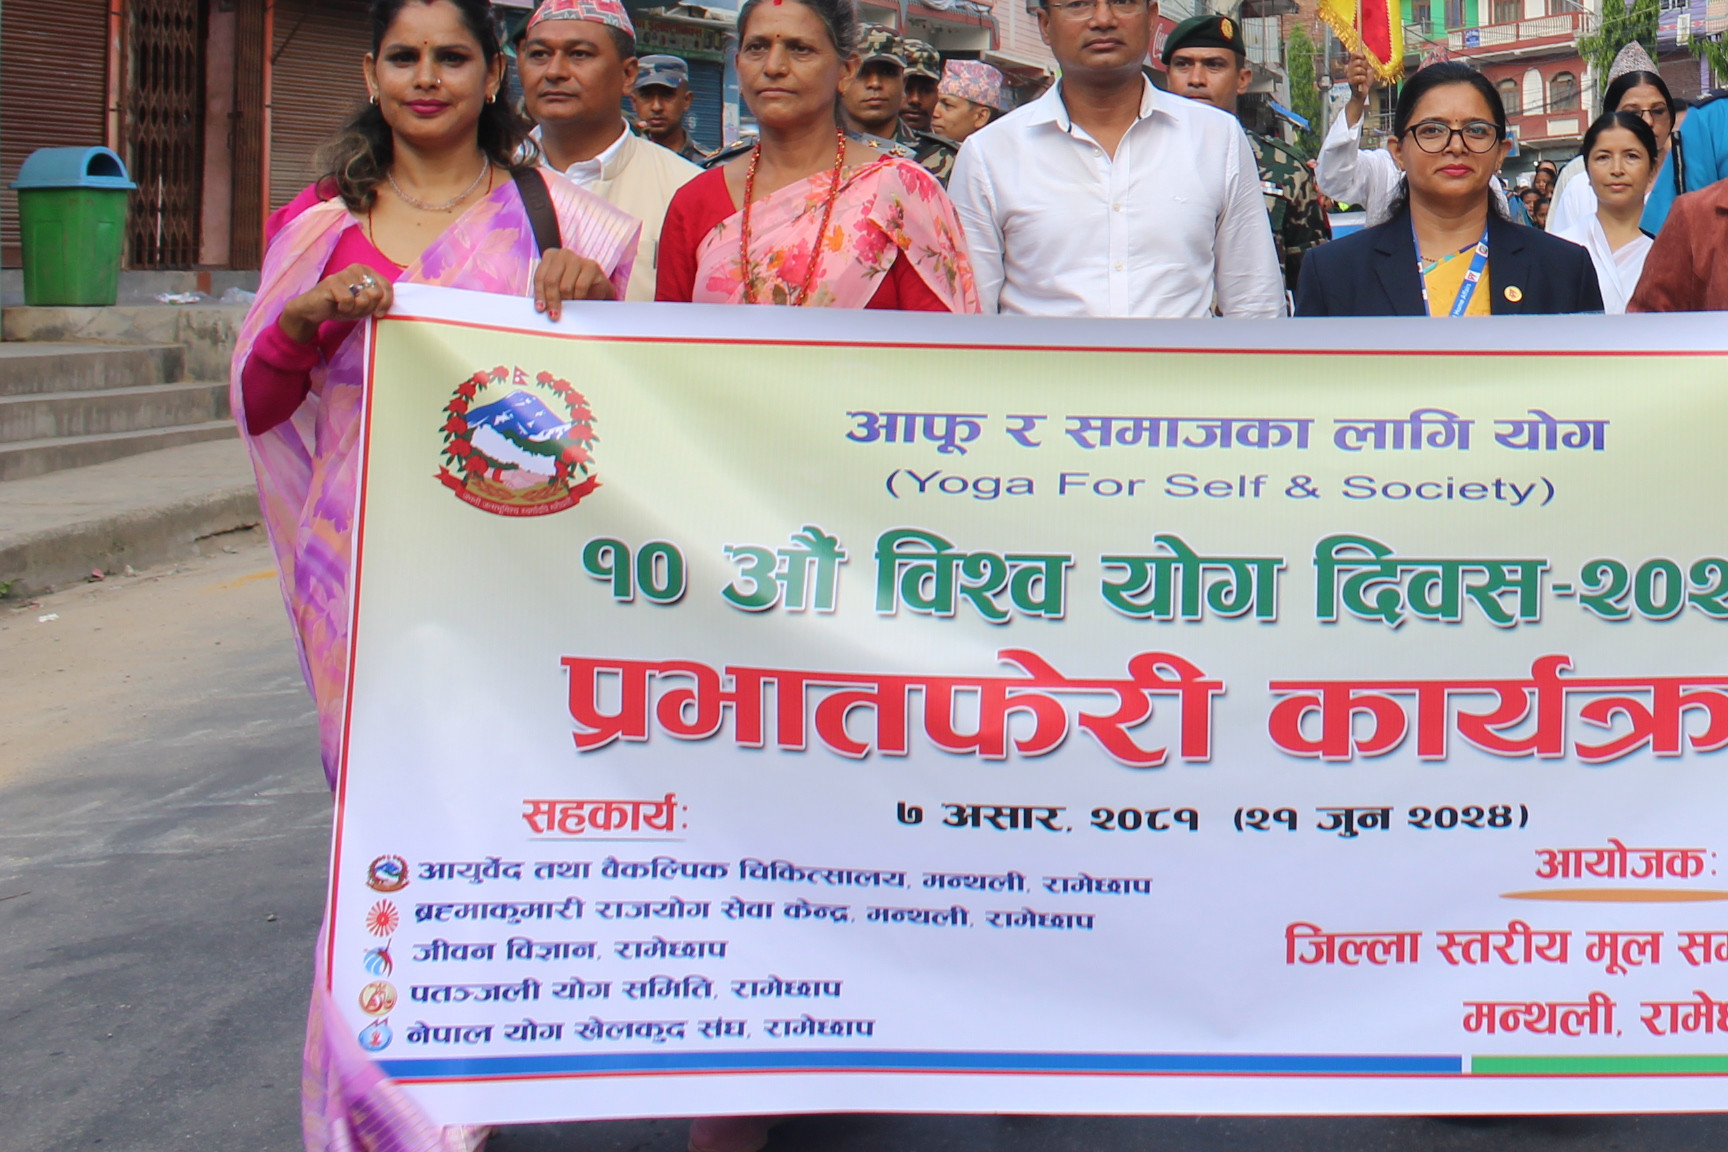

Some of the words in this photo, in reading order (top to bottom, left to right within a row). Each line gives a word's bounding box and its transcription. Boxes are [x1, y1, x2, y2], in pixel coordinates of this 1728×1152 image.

[1453, 299, 1465, 316] Home
[1460, 282, 1473, 300] Affairs
[846, 411, 988, 455] आफू
[1005, 415, 1048, 448] र
[1065, 415, 1315, 450] समाजका
[1333, 408, 1475, 451] लागि
[1493, 408, 1611, 451] योग
[886, 469, 1035, 500] (Yoga
[1058, 473, 1145, 496] For
[1164, 474, 1268, 498] Self
[1285, 476, 1320, 498] &
[1342, 475, 1556, 507] Society)
[582, 537, 690, 608] १०
[875, 527, 1077, 626] विश्व
[1100, 533, 1288, 624] योग
[561, 648, 1227, 770] प्रभातफेरी
[896, 801, 924, 826] ७
[1090, 806, 1200, 832] २०८१
[1233, 807, 1298, 832] (२१
[1315, 806, 1395, 839] जुन
[1407, 804, 1529, 830] २०२४)
[418, 857, 525, 884] आयुर्वेद
[534, 861, 592, 880] तथा
[601, 856, 731, 881] वैकल्पिक
[1042, 872, 1153, 895] रामेछाप
[1534, 838, 1718, 880] आयोजक:
[414, 897, 585, 924] ब्रह्माकुमारी
[596, 896, 711, 920] राजयोग
[721, 896, 774, 920] सेवा
[985, 907, 1096, 931] रामेछाप
[412, 938, 498, 962] जीवन
[614, 935, 729, 960] रामेछाप
[1284, 921, 1423, 966] जिल्ला
[1435, 919, 1573, 966] स्तरीय
[1585, 930, 1666, 976] मूल
[551, 975, 612, 1001] योग
[730, 974, 843, 999] रामेछाप
[406, 1020, 495, 1046] नेपाल
[503, 1017, 565, 1043] योग
[575, 1015, 687, 1043] खेलकुद
[763, 1013, 876, 1038] रामेछाप
